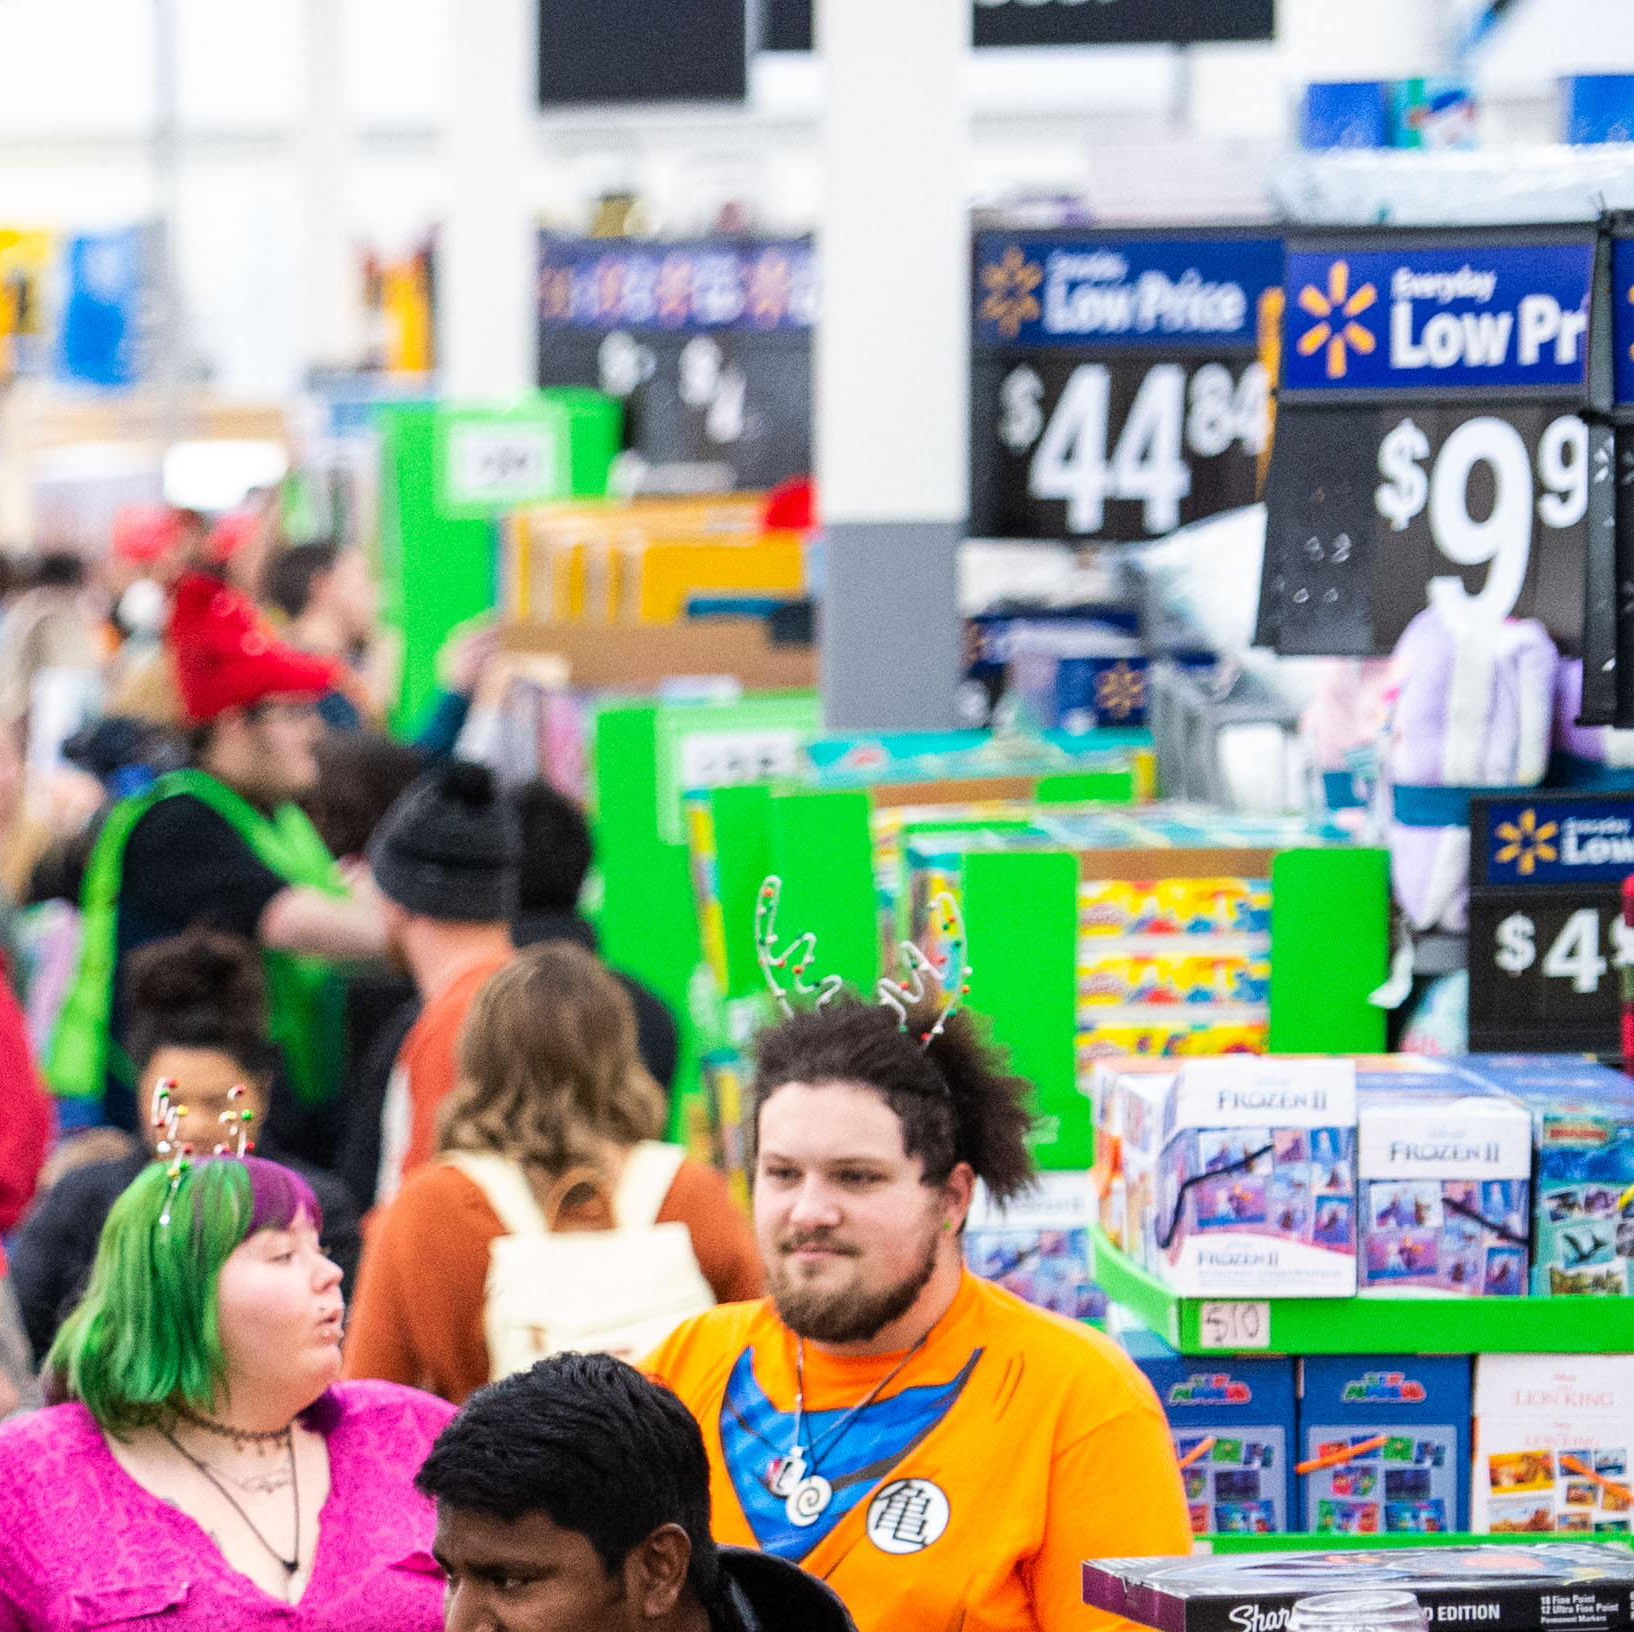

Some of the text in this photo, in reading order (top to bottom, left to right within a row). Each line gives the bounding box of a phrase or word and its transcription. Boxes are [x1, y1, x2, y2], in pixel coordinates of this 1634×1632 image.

[1392, 265, 1497, 303] Everyday
[1134, 268, 1248, 333] Price
[1390, 294, 1588, 368] Low Pr
[1218, 1090, 1309, 1110] FROZEN
[1390, 1144, 1481, 1163] FROZEN
[1198, 1252, 1265, 1266] FROZEN
[1515, 1391, 1614, 1408] LION KING
[1573, 1594, 1595, 1603] Point
[1596, 1603, 1619, 1612] Point
[1438, 1604, 1500, 1621] EDITION
